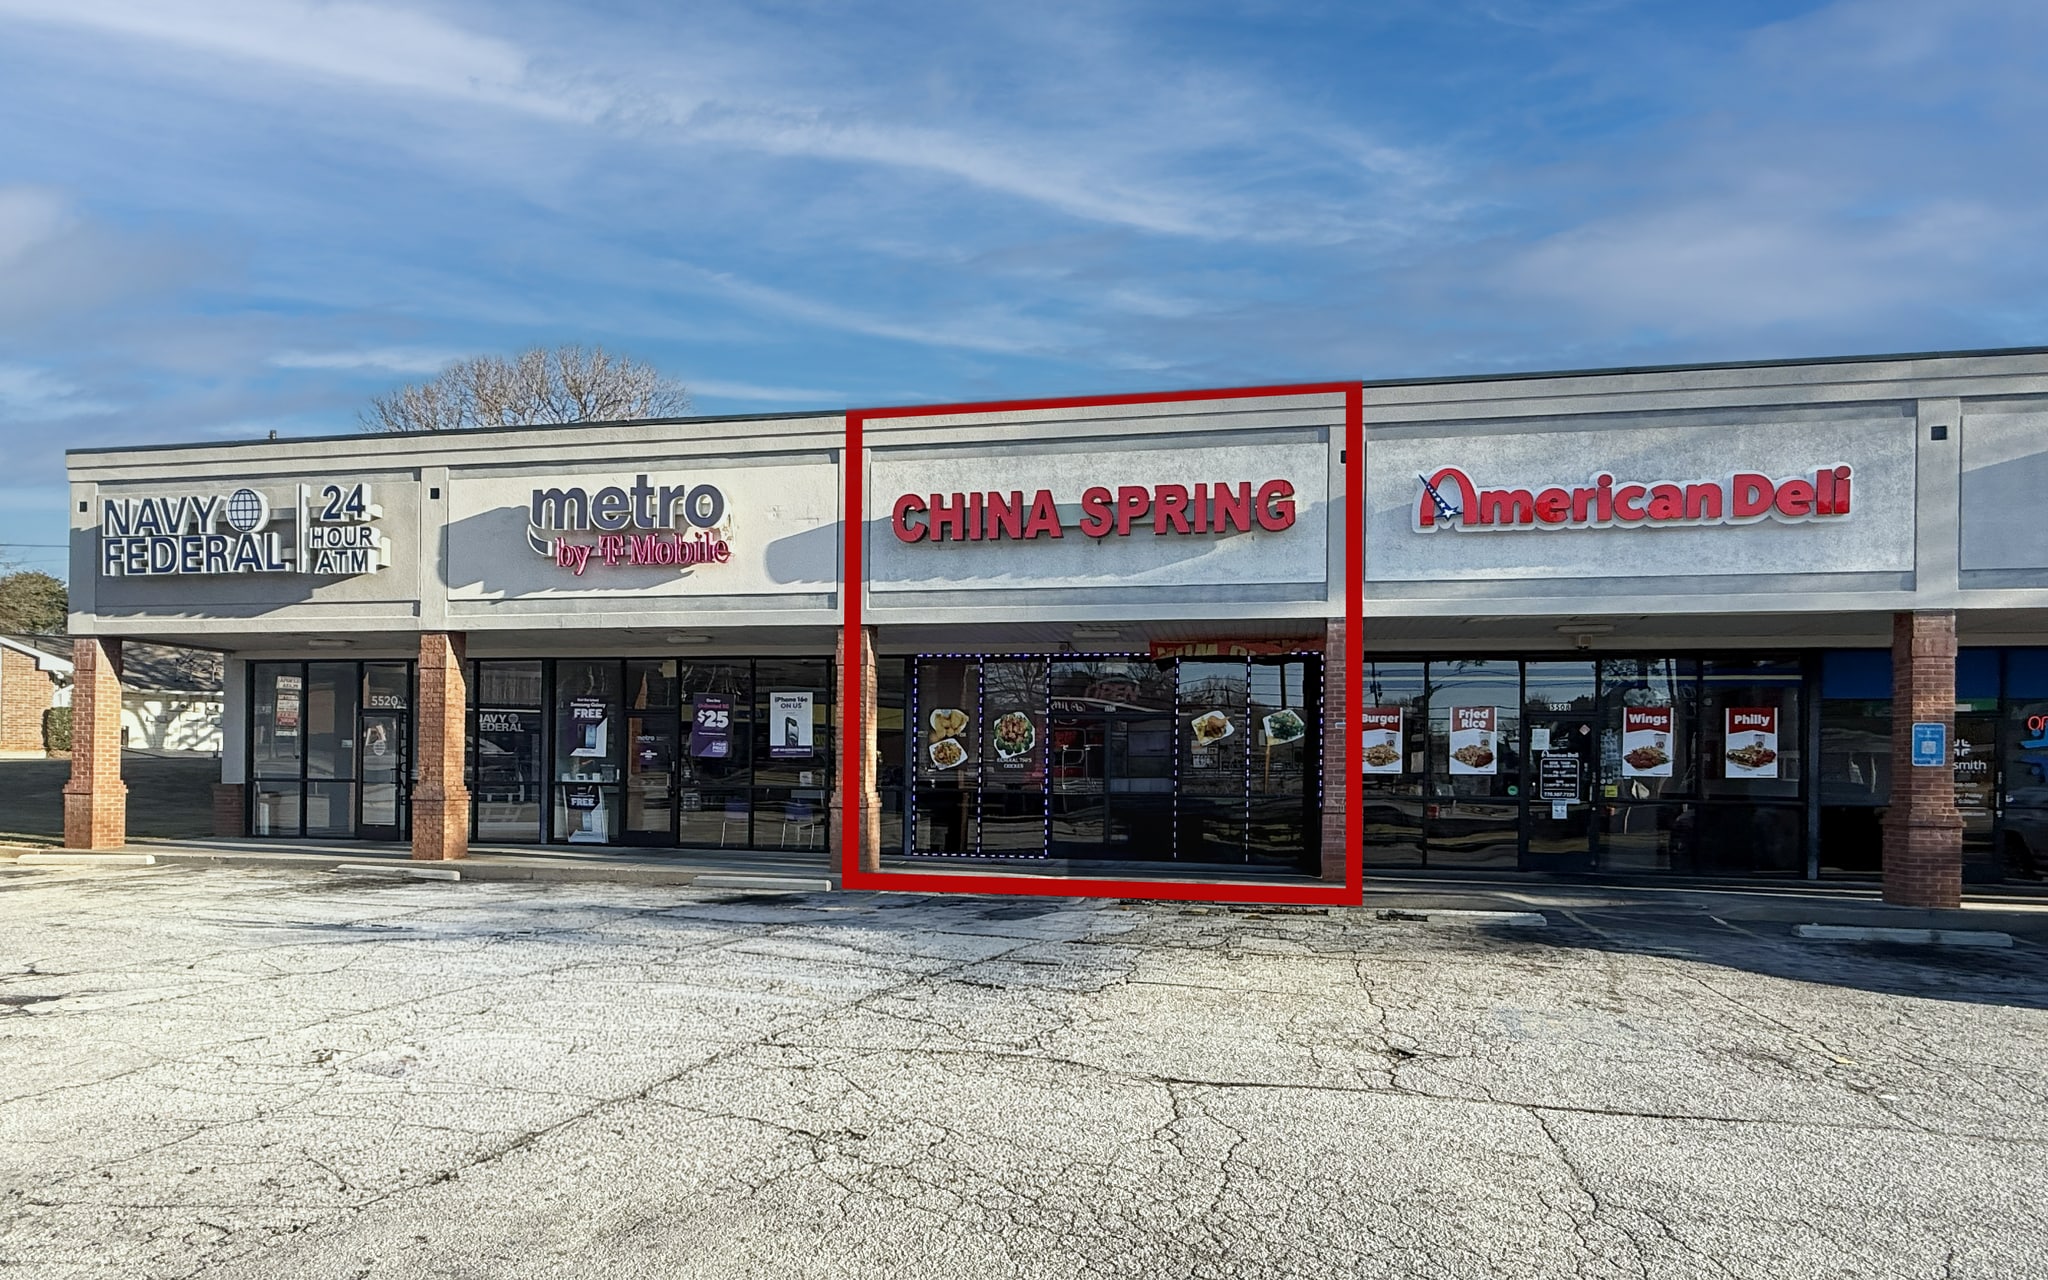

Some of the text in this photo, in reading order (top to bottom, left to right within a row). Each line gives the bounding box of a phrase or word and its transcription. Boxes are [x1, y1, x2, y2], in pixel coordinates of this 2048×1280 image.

[320, 484, 368, 522] 24
[529, 474, 727, 531] metro
[1418, 465, 1852, 527] American Deli
[103, 494, 219, 537] NAVY
[892, 479, 1296, 544] CHINA SPRING
[310, 526, 375, 549] HOUR
[103, 533, 287, 576] FEDERAL
[314, 550, 369, 575] ATM
[555, 536, 593, 576] by
[573, 708, 603, 719] FREE
[697, 709, 729, 728] $25
[1362, 713, 1400, 727] Burger
[1459, 709, 1489, 719] Fried
[1628, 713, 1668, 726] Wings
[1734, 714, 1771, 726] Philly
[480, 723, 525, 732] EDERAL
[1461, 719, 1487, 729] Rice
[1953, 760, 1987, 770] smith
[571, 797, 596, 807] FREE
